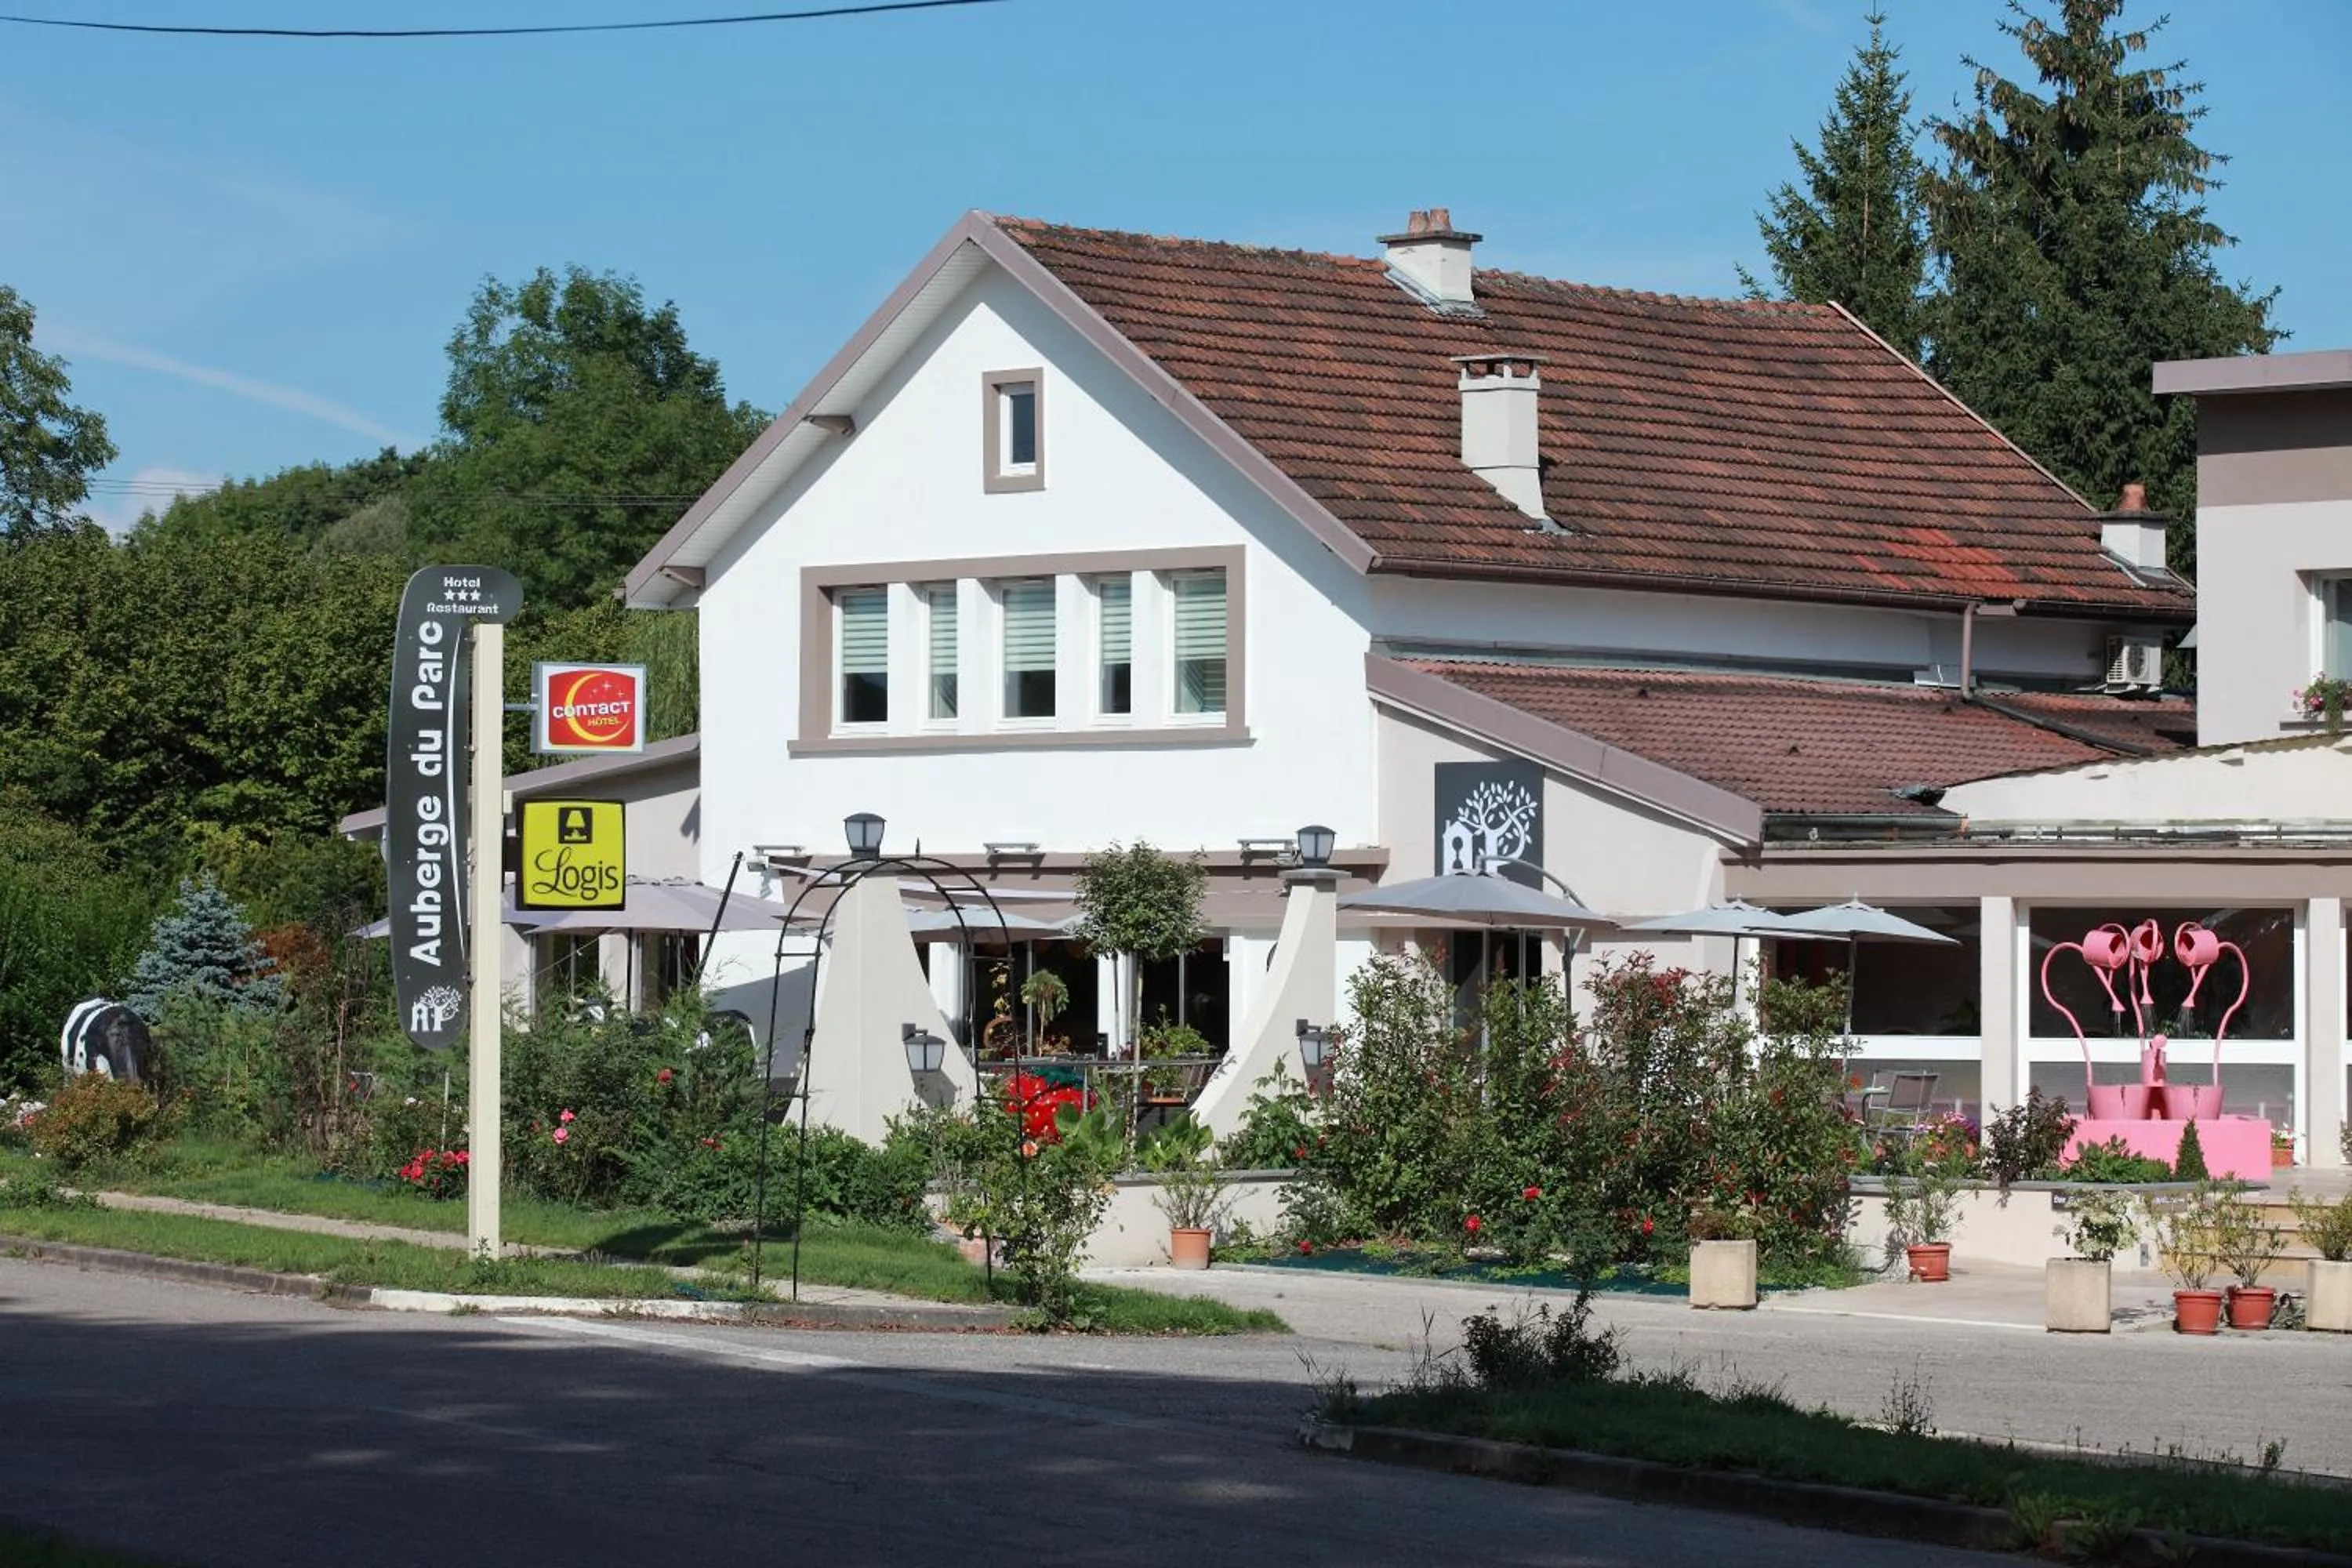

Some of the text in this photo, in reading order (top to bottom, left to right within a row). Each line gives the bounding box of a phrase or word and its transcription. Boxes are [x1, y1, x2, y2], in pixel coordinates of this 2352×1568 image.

[444, 576, 481, 587] Hotel
[426, 602, 499, 614] Restaurant
[409, 620, 449, 967] Auberge du Parc
[532, 847, 619, 901] Logis
